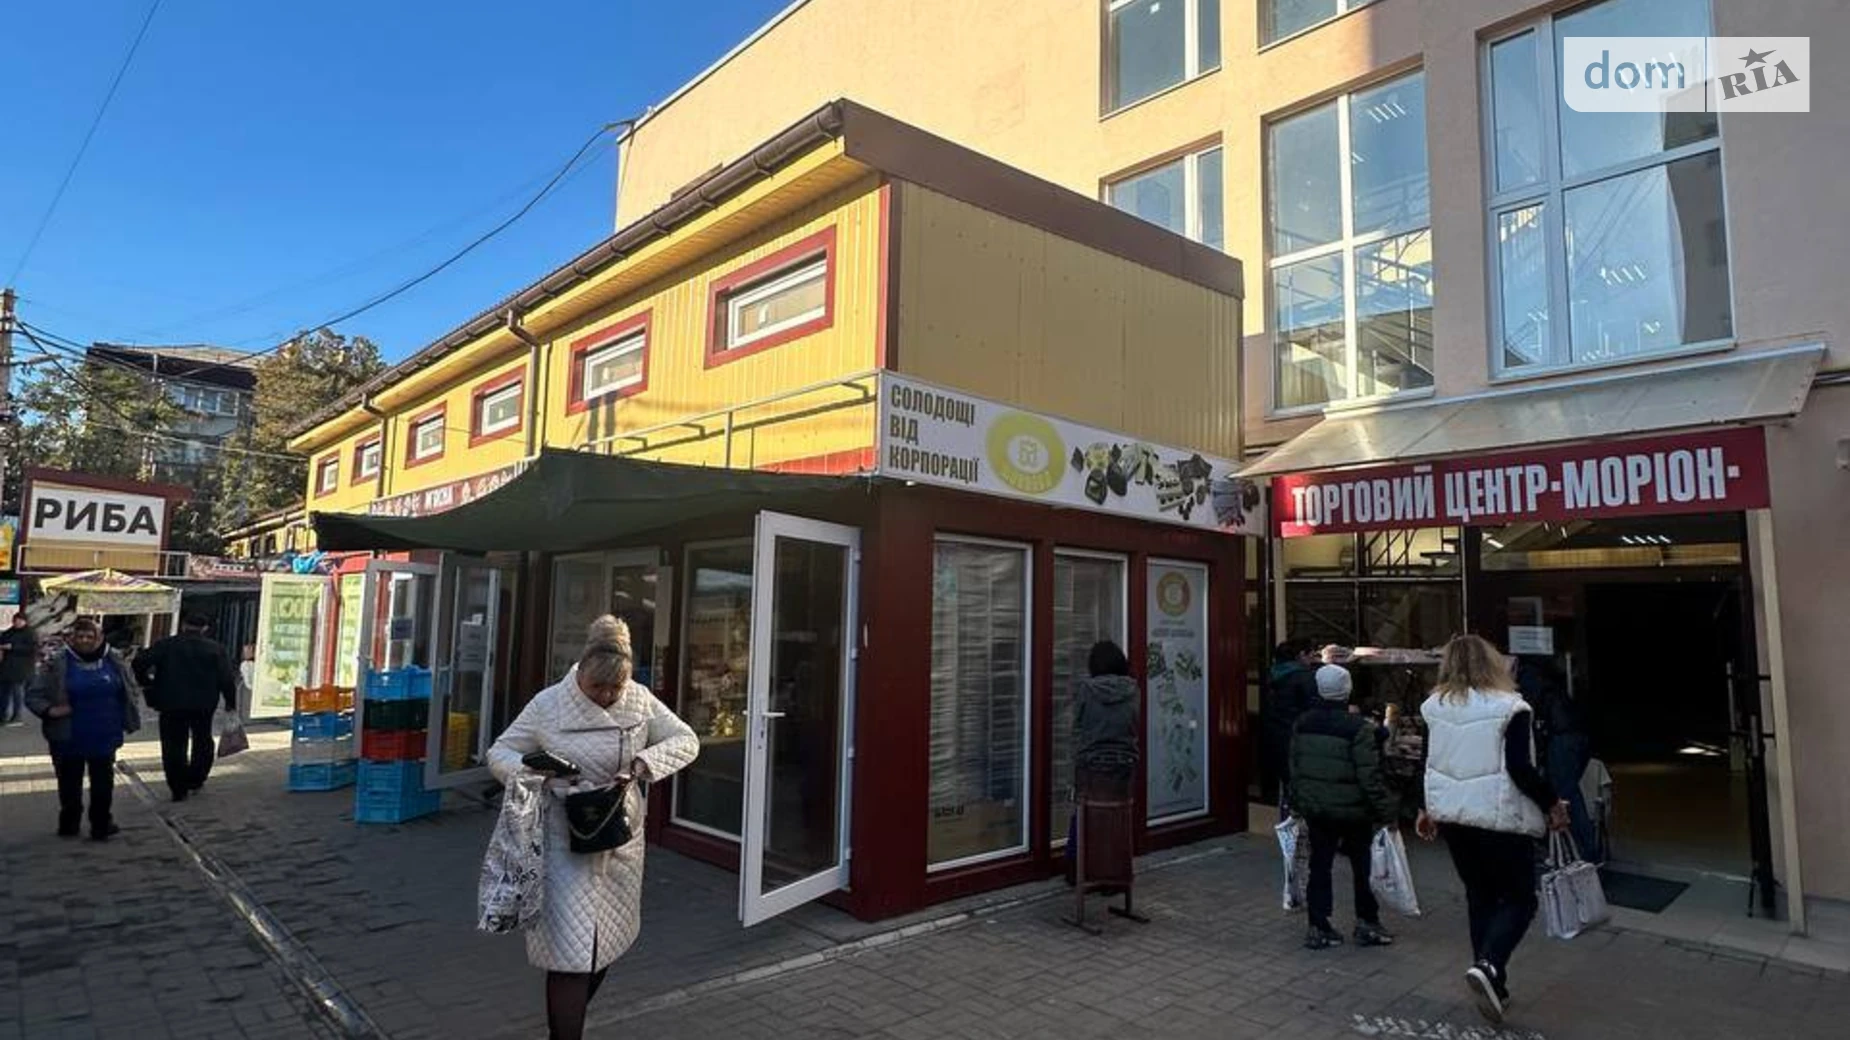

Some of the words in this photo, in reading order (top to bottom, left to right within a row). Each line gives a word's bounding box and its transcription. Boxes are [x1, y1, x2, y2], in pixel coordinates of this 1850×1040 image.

[890, 383, 976, 426] СОЛОДОЩІ
[889, 413, 919, 445] ВІД
[888, 444, 980, 484] КОРПОРАЦІЇ
[1291, 464, 1436, 527] ТОРГОВИЙ
[34, 498, 159, 537] РИБА
